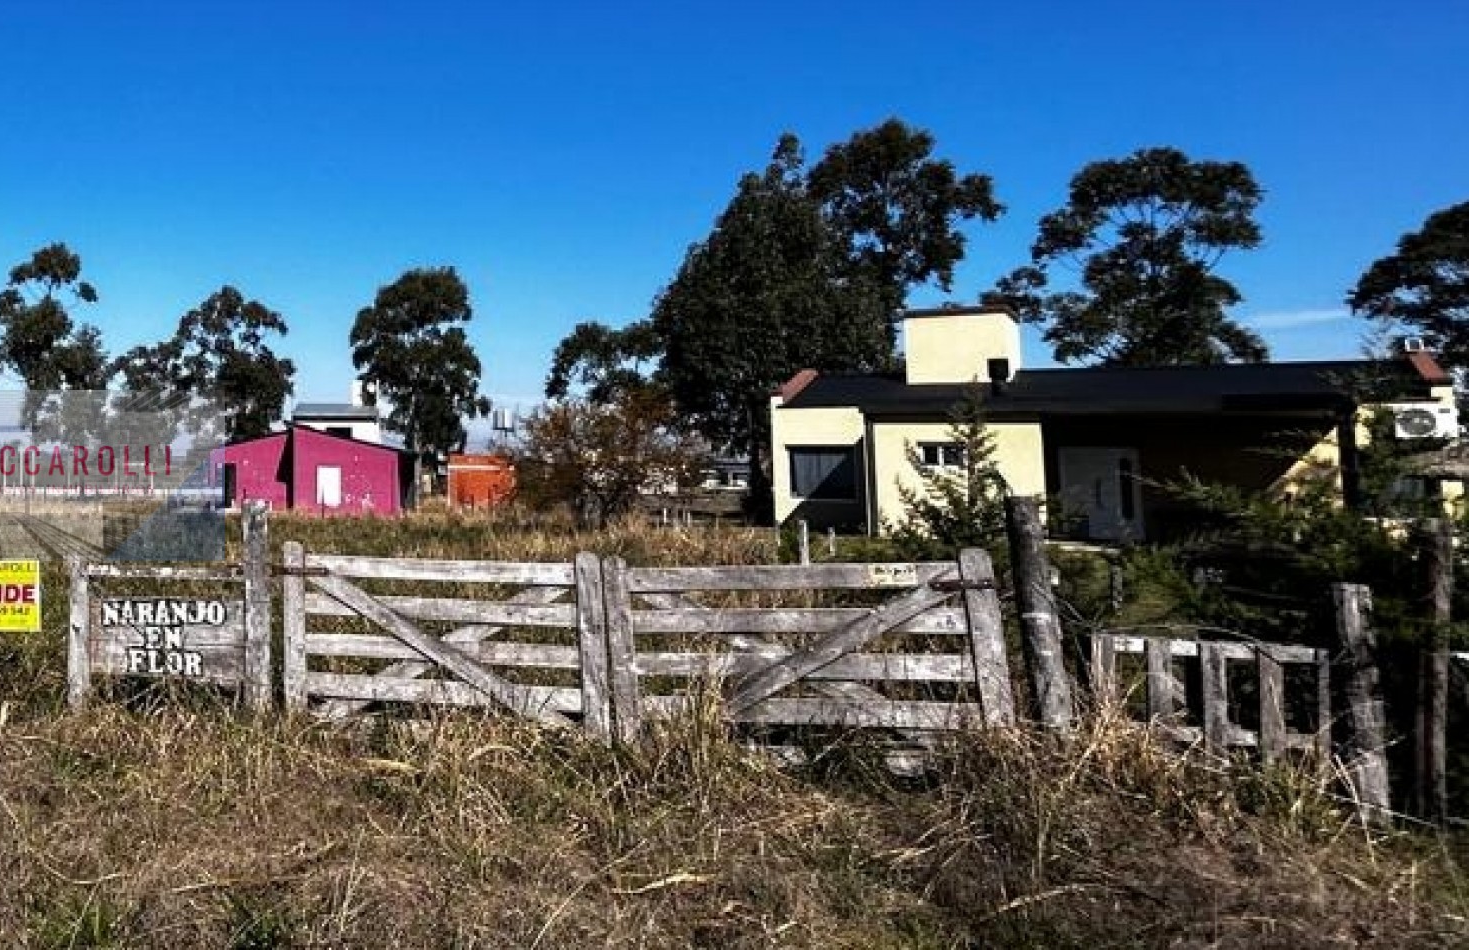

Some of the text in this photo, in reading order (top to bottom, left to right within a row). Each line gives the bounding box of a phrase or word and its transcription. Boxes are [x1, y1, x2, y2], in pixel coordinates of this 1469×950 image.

[101, 600, 227, 626] NARANJO
[143, 626, 182, 649] EN
[127, 648, 203, 675] FLOR
